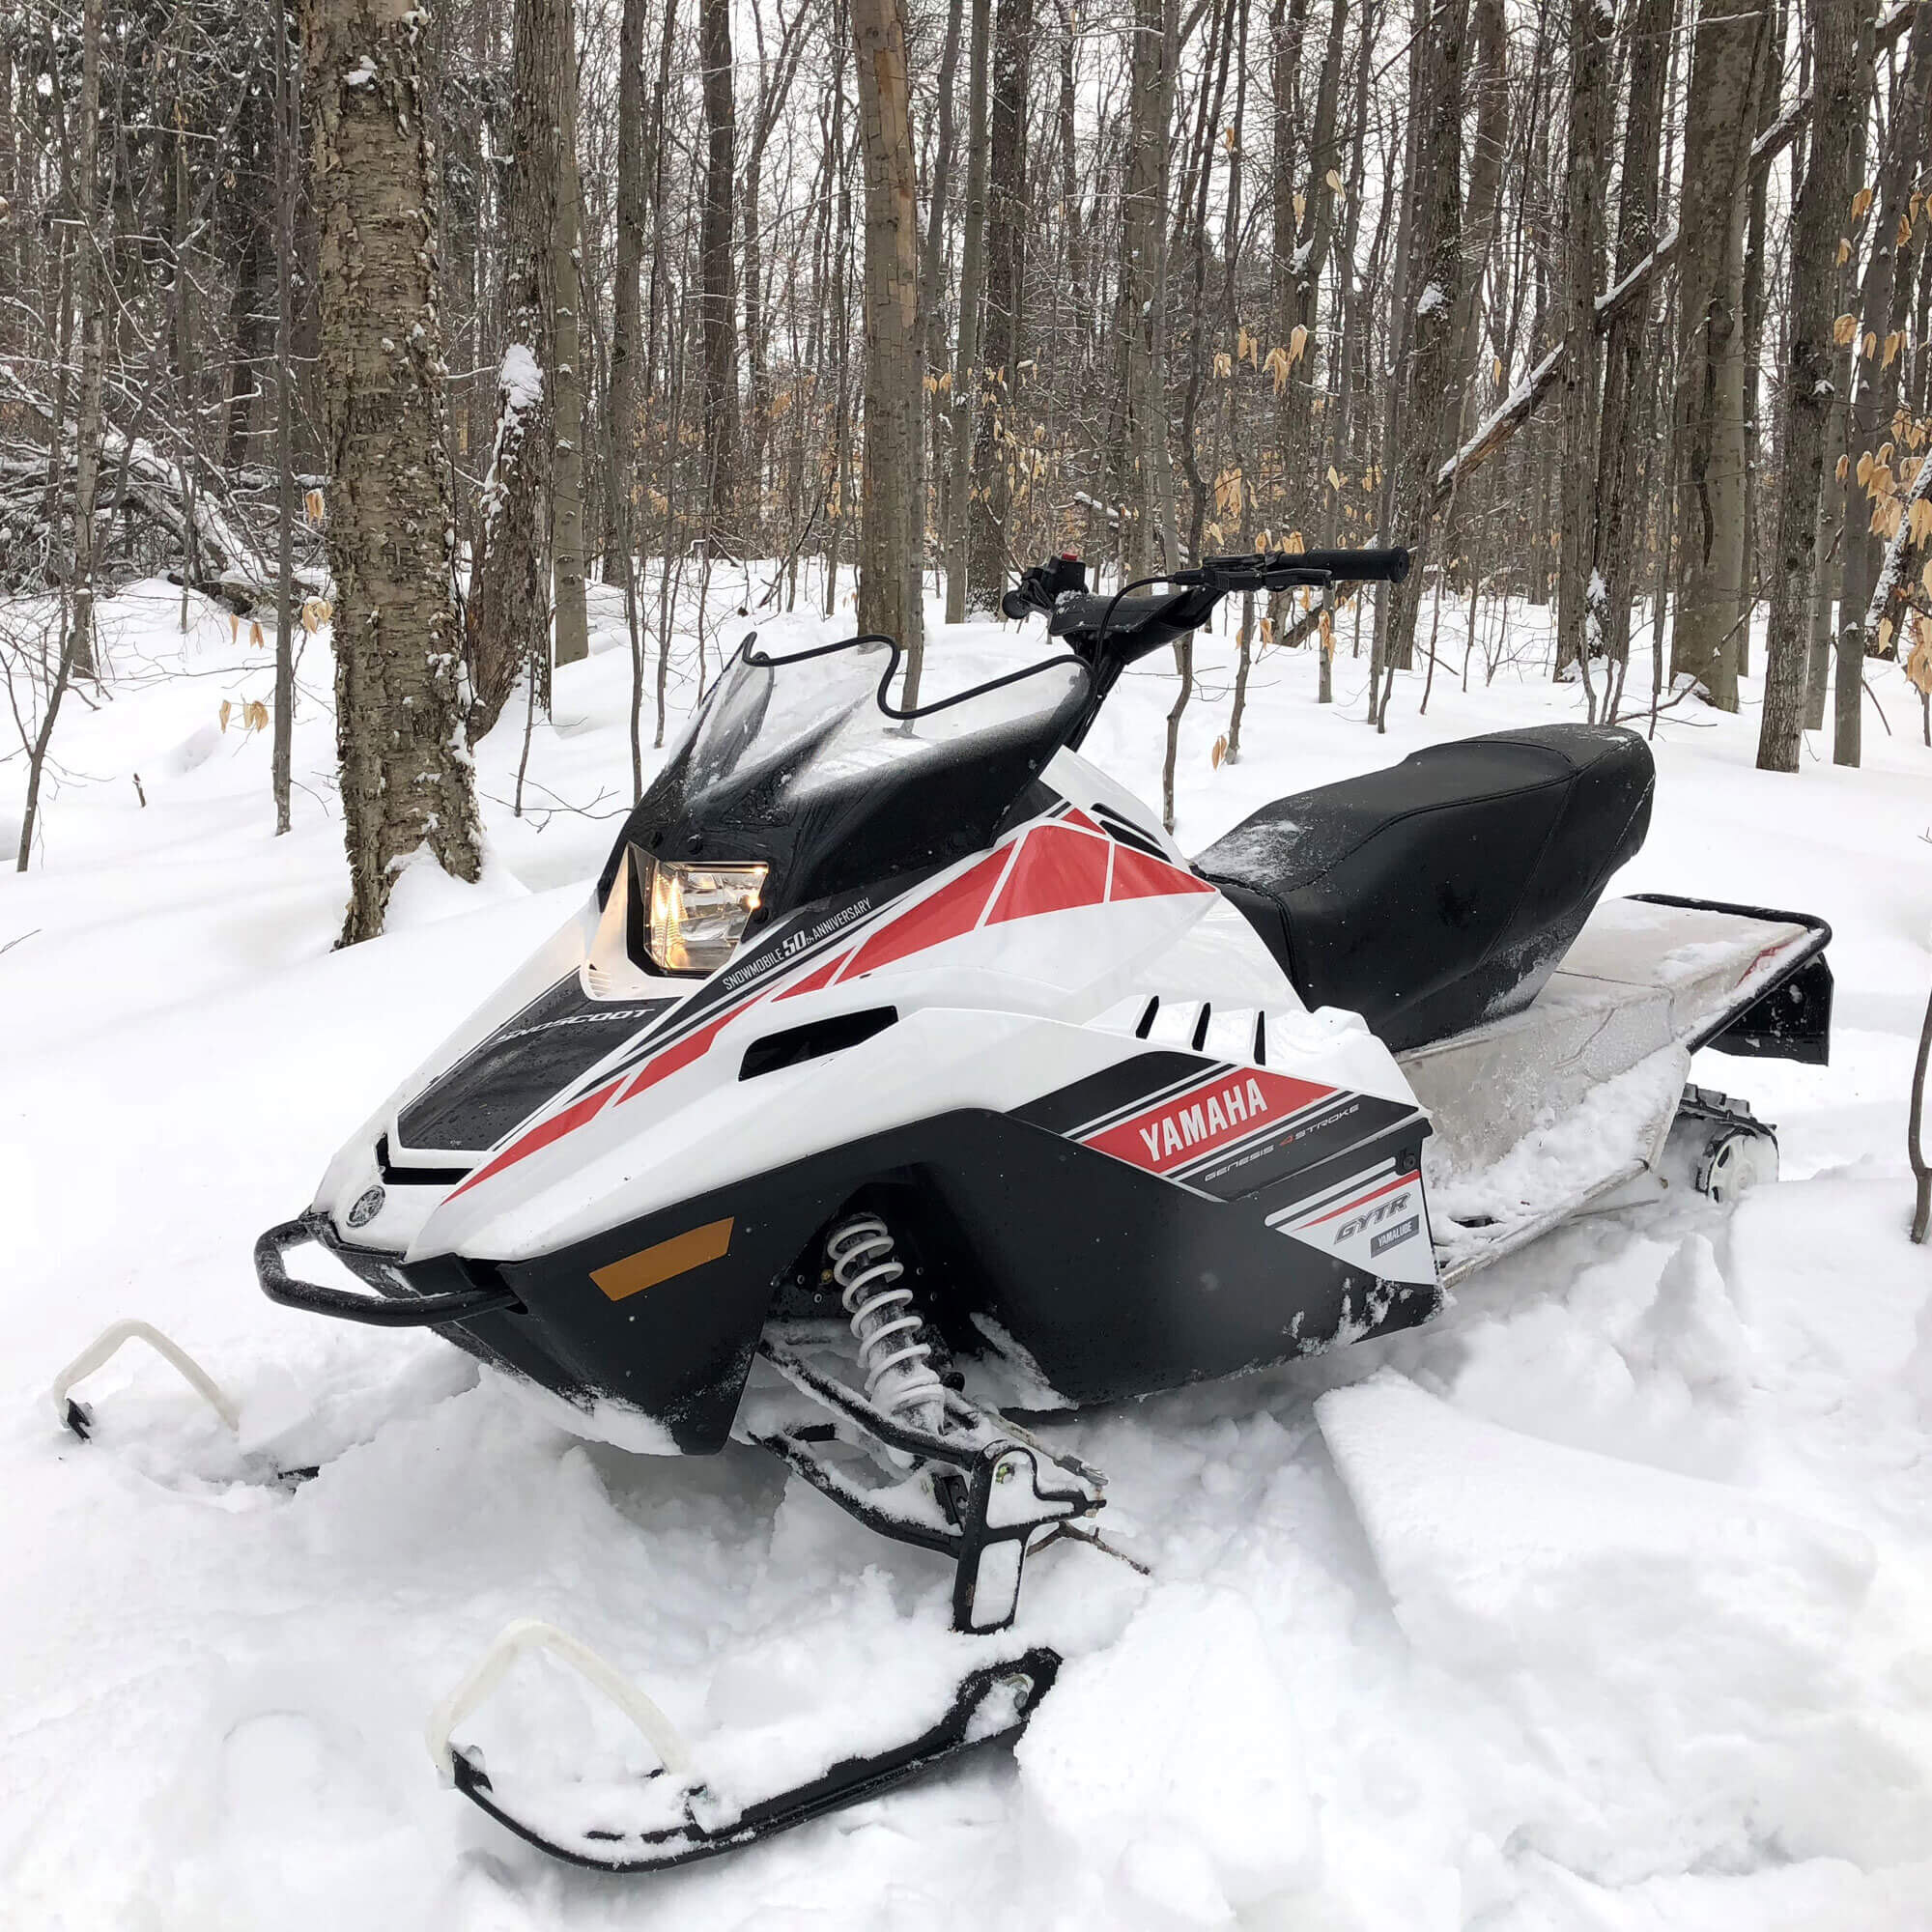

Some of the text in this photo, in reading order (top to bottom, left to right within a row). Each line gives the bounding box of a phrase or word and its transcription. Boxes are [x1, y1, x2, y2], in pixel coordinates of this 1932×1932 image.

[723, 947, 784, 991] SNOWMOBILE
[813, 897, 872, 937] ANNIVERSARY
[1139, 1078, 1267, 1162] YAMAHA
[1334, 1192, 1411, 1244] GYTR
[1378, 1221, 1413, 1247] YAMALUBE
